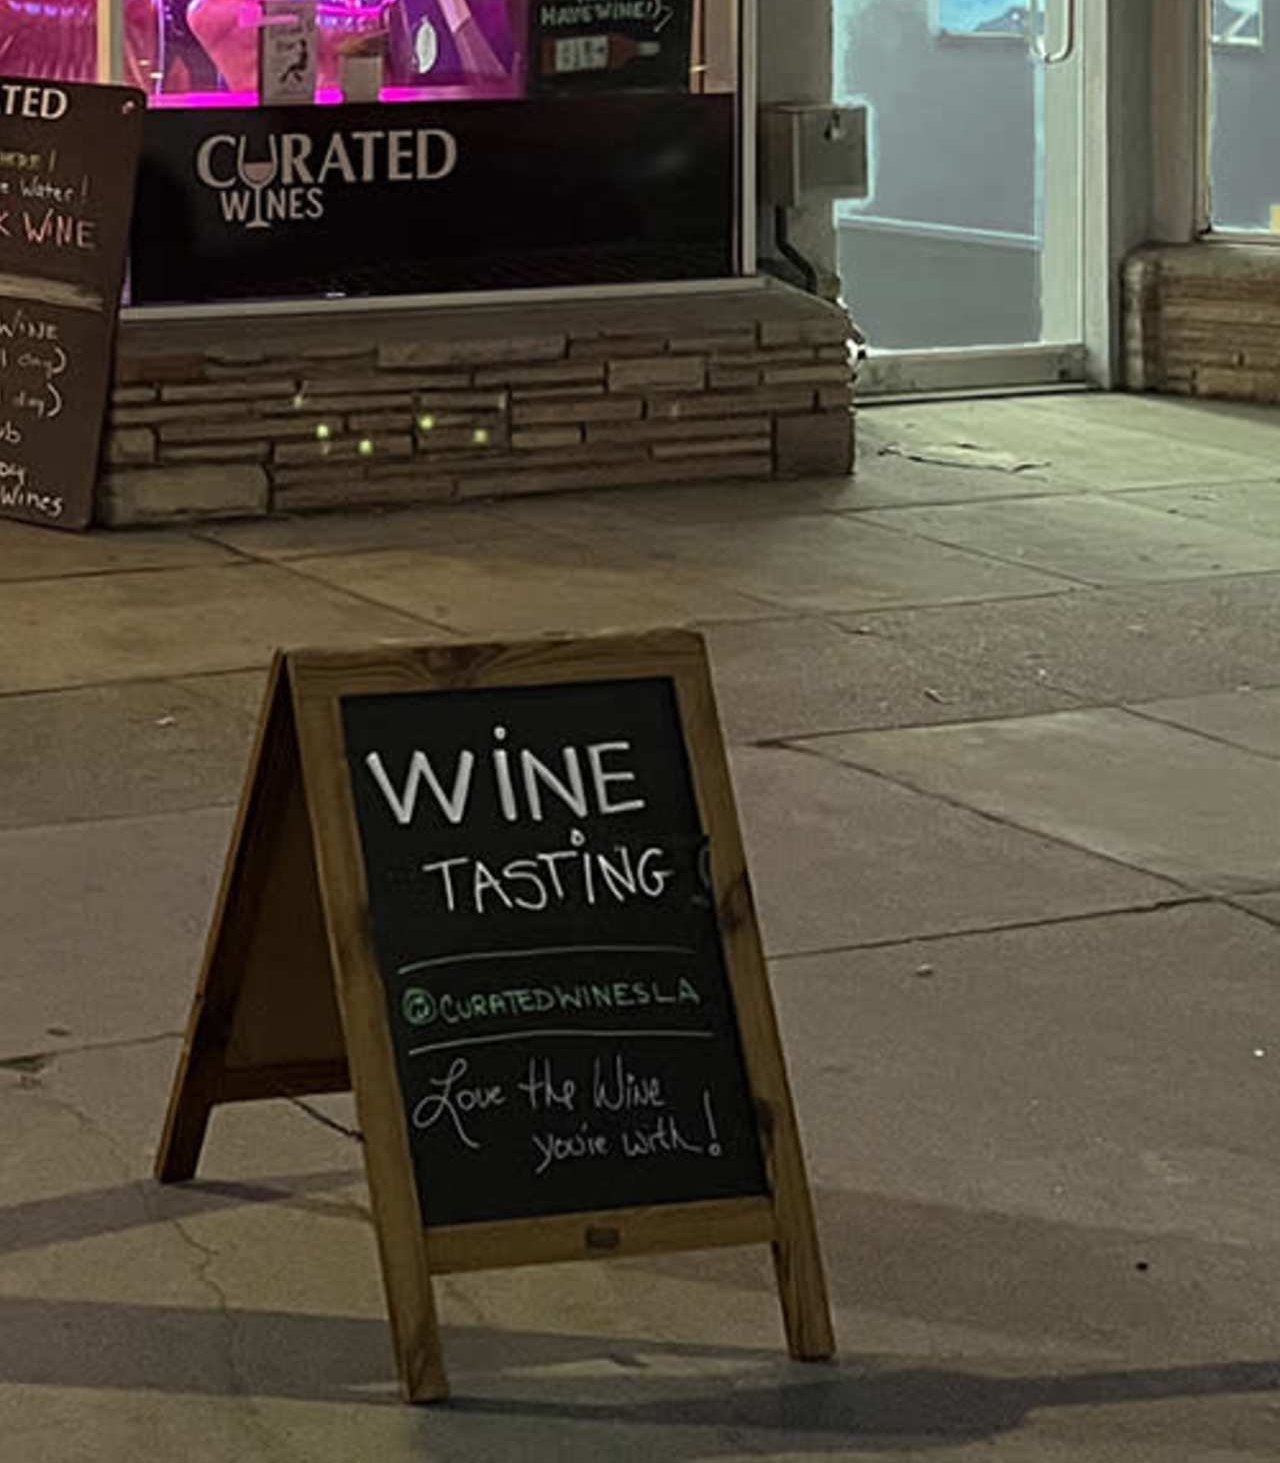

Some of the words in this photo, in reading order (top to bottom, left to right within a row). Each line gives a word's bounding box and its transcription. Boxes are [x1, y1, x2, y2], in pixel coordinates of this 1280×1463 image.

[197, 128, 458, 190] CURATED
[220, 187, 324, 229] WINES
[411, 1057, 508, 1149] Love
[517, 1057, 577, 1112] the
